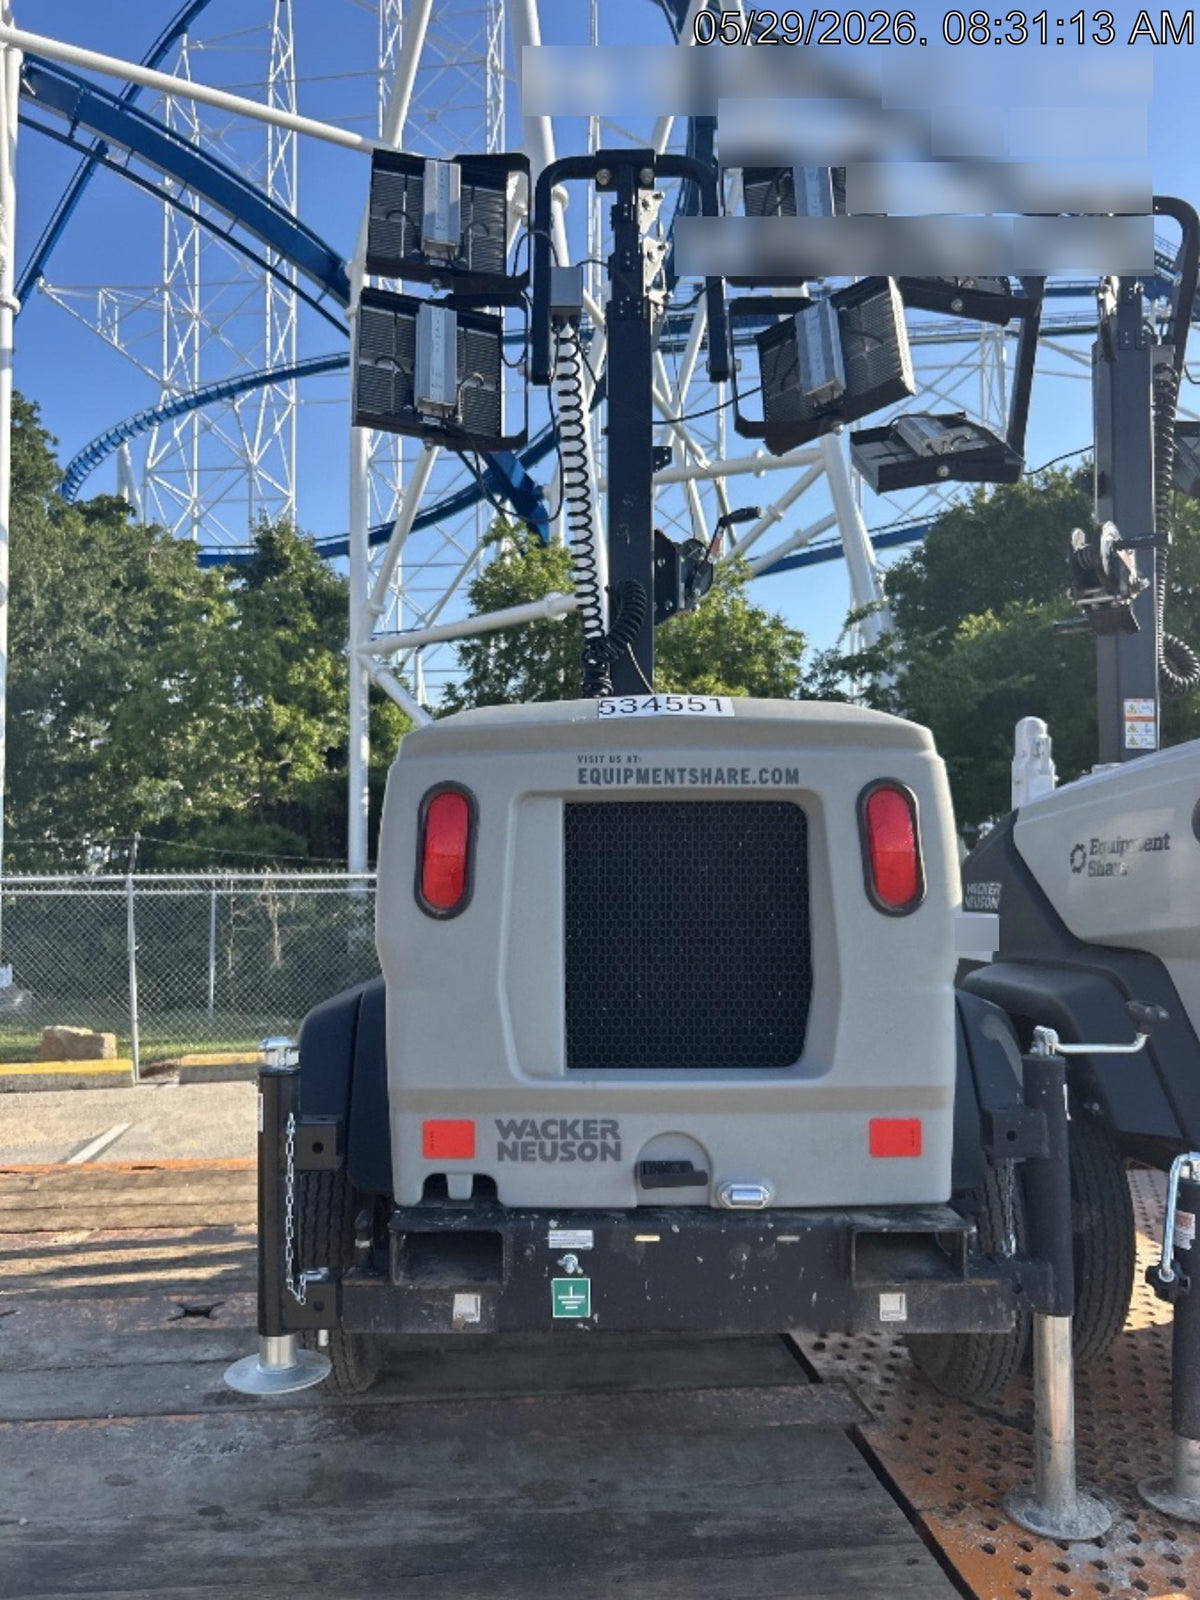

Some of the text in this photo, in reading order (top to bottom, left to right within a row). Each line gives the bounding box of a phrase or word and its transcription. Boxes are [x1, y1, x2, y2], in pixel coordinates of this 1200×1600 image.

[599, 696, 722, 716] 534551
[577, 755, 605, 764] VISIT
[609, 755, 621, 764] US
[578, 767, 799, 786] EQUIPMENTSHARE.COM
[494, 1119, 620, 1140] WACKER
[497, 1140, 622, 1162] NEUSON
